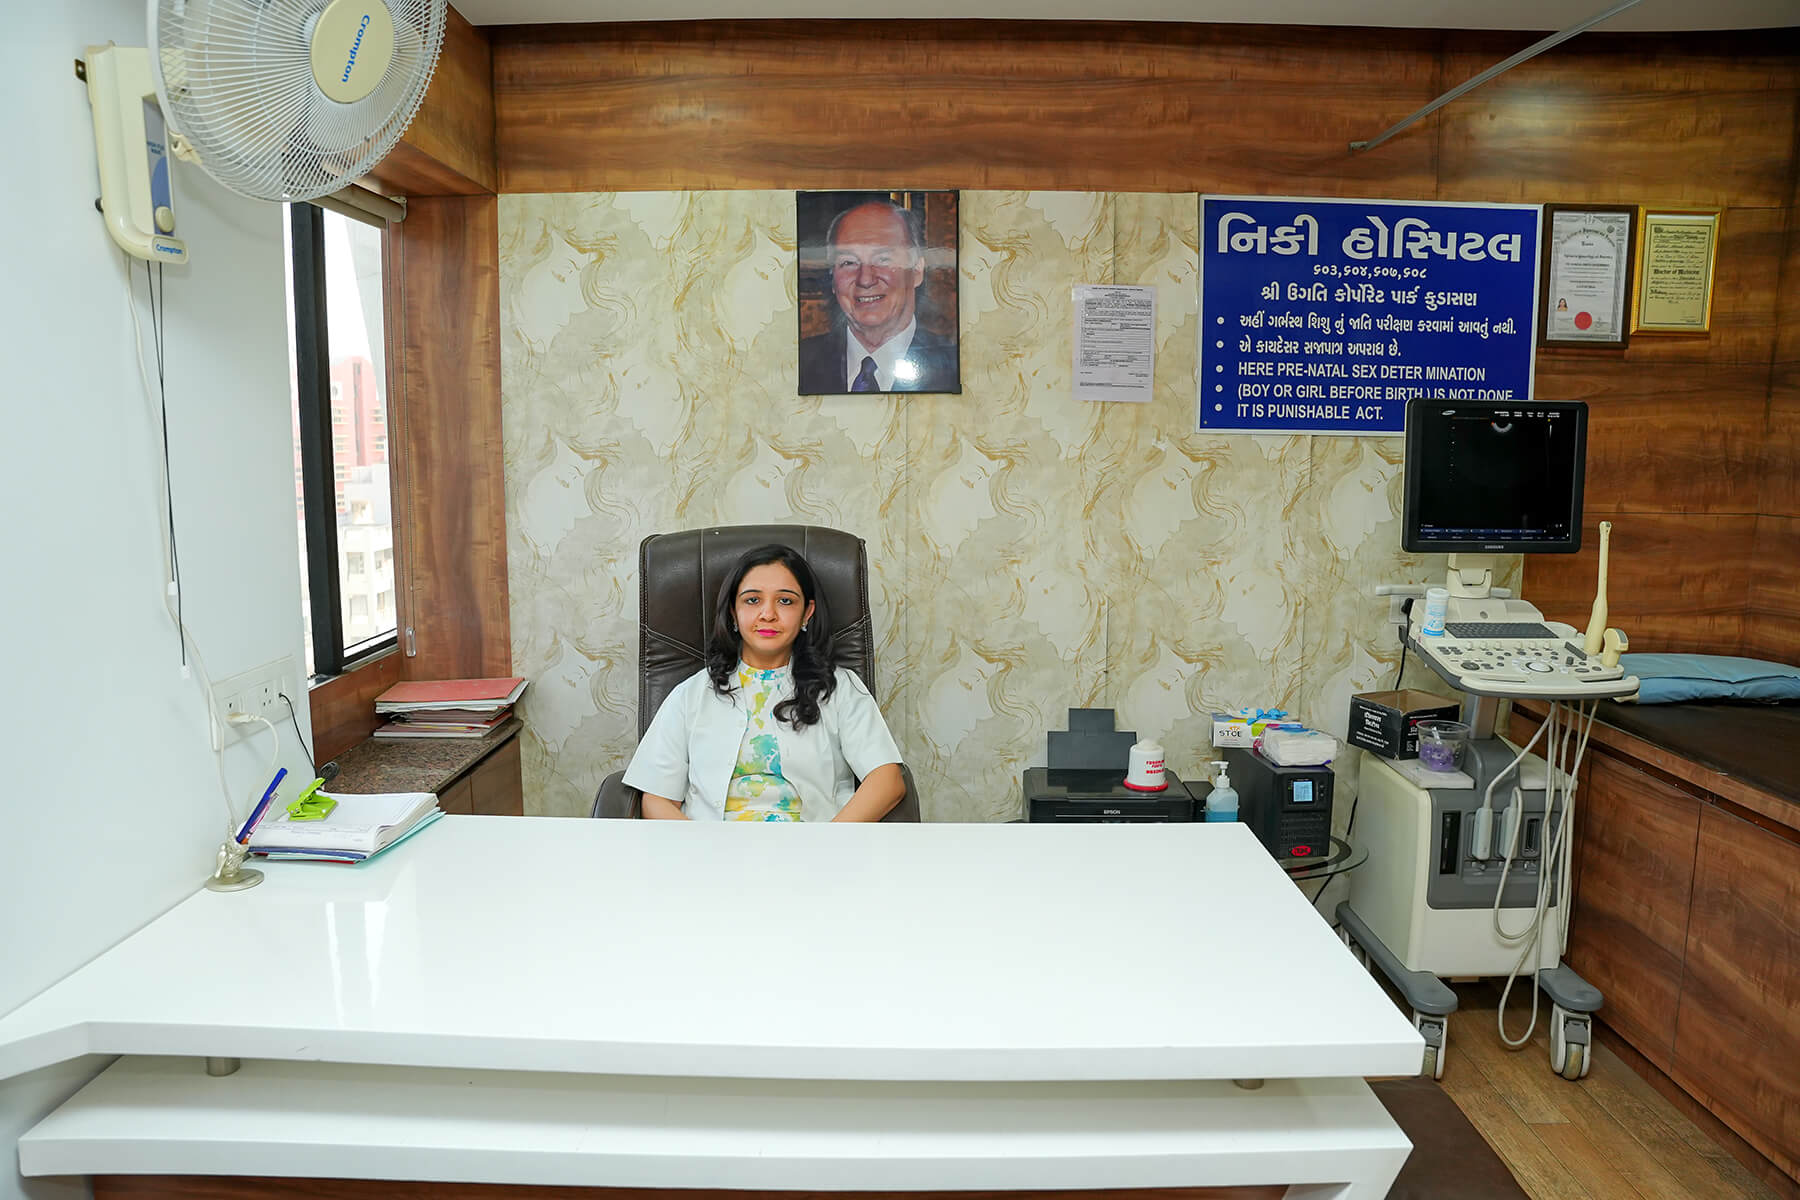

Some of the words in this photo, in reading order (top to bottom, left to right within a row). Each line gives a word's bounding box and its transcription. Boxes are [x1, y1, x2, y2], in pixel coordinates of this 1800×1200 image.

[341, 14, 370, 83] Crompton
[1218, 212, 1319, 256] નિકી
[1341, 215, 1522, 262] હોસ્પિટલ
[155, 243, 183, 255] Crompton
[1260, 281, 1280, 301] શ્રી
[1287, 282, 1328, 302] ઉગતિ
[1390, 285, 1421, 305] પાર્ક
[1424, 291, 1477, 312] કુડાસણ
[1239, 309, 1265, 329] અહીં
[1267, 311, 1303, 329] ગર્ભસ્થ
[1307, 311, 1332, 335] શિશુ
[1334, 312, 1345, 335] નું
[1348, 313, 1372, 331] જાતિ
[1375, 313, 1413, 333] પરીક્ષણ
[1416, 316, 1454, 333] કરવામાં
[1457, 317, 1489, 340] આવતું
[1492, 317, 1517, 335] નથી.
[1239, 334, 1252, 353] એ
[1255, 335, 1299, 354] કાયદેસર
[1303, 341, 1343, 355] સજાપાત્ર
[1347, 342, 1384, 357] અપરાધ
[1388, 338, 1401, 357] છે.
[1238, 361, 1274, 376] HERE
[1277, 362, 1349, 378] PRE-NATAL
[1351, 364, 1378, 379] SEX
[1425, 366, 1486, 382] MINATION
[1238, 383, 1271, 401] (BOY
[1273, 383, 1293, 398] OR
[1295, 384, 1327, 399] GIRL
[1329, 385, 1382, 400] BEFORE
[1385, 386, 1423, 401] BIRTH
[1433, 387, 1446, 400] IS
[1448, 388, 1476, 400] NOT
[1477, 389, 1513, 401] DONE
[1237, 403, 1250, 418] IT
[1252, 403, 1265, 418] IS
[1267, 404, 1350, 420] PUNISHABLE
[1355, 405, 1384, 420] ACT.
